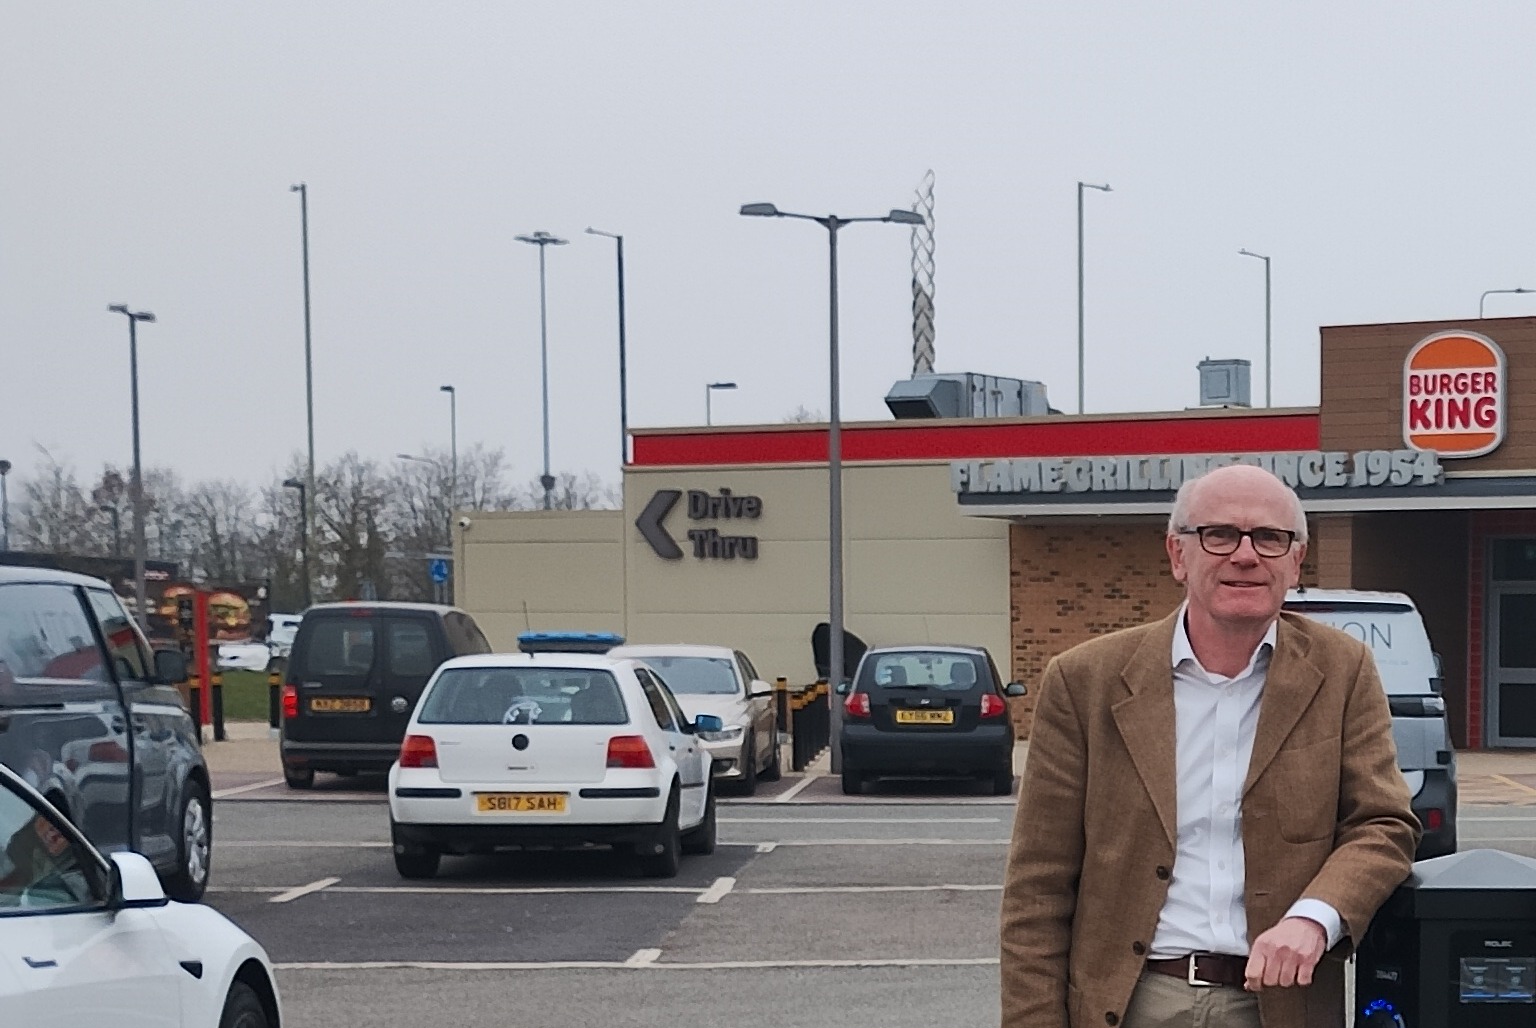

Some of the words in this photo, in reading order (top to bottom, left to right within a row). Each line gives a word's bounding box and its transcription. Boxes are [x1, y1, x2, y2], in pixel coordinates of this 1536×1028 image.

[1409, 371, 1497, 396] BURGER
[1409, 396, 1497, 430] KING
[951, 458, 1064, 493] FLAME
[1065, 453, 1235, 492] GRILLIN
[687, 486, 763, 520] Drive
[687, 528, 759, 560] Thru
[526, 796, 557, 810] SAH
